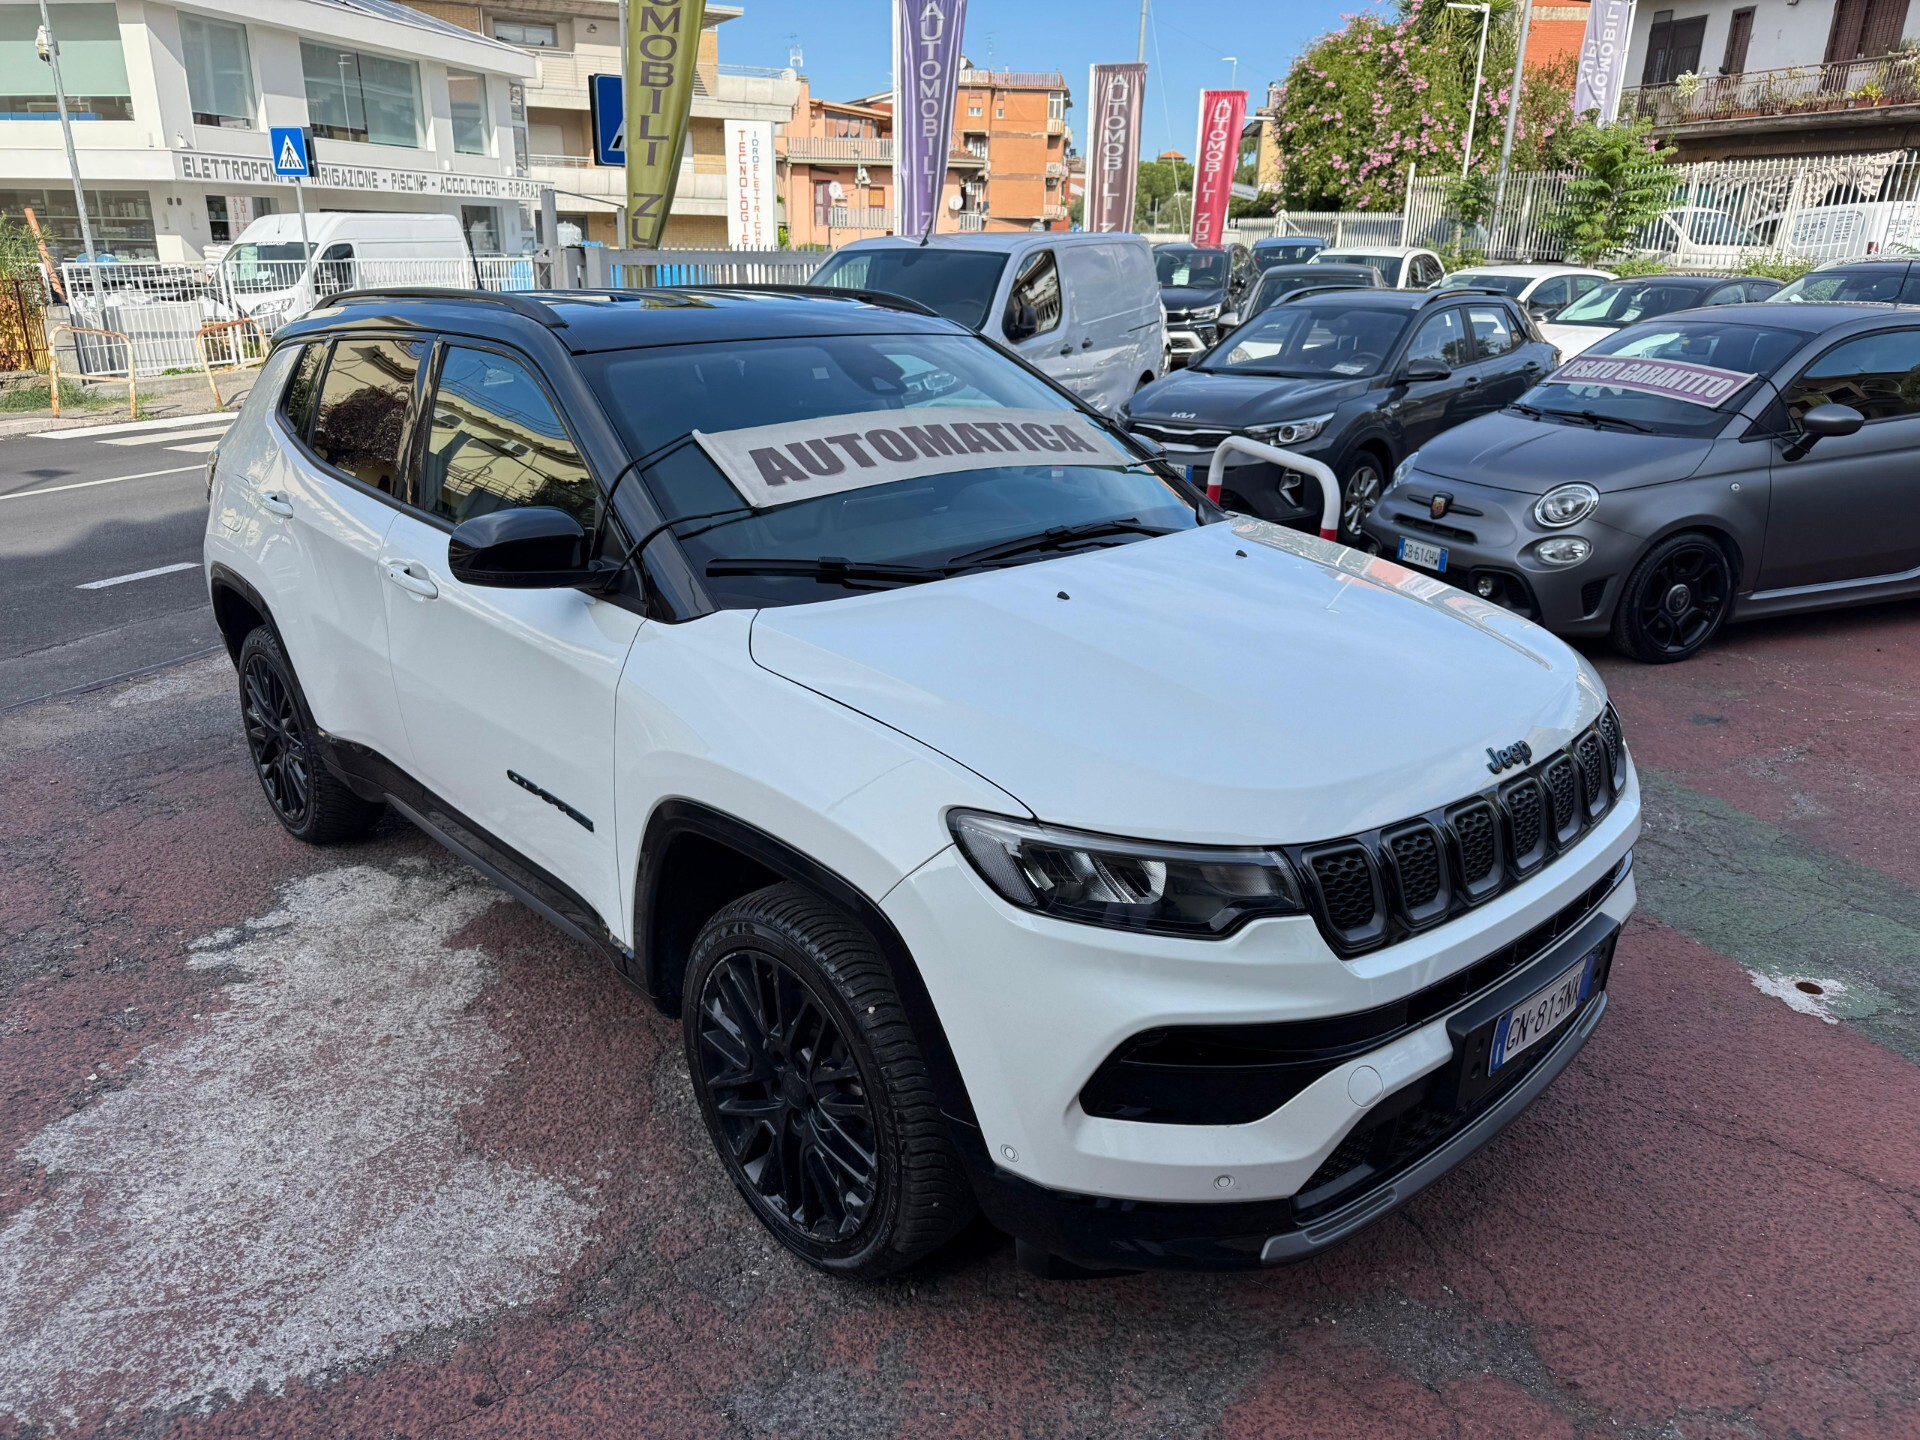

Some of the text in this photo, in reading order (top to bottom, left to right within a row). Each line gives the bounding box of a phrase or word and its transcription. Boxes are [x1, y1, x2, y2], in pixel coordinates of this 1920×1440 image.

[638, 0, 681, 166] MOBILI
[920, 1, 945, 193] AUTOMOBILI
[738, 130, 749, 245] TECNOLOGIE
[752, 130, 762, 245] IDROELETTRICHE
[1102, 74, 1129, 210] AUTOMOBILI
[1202, 99, 1231, 203] AUTOMOBILI
[1561, 360, 1735, 398] USATO GARANTITO
[748, 422, 1098, 486] AUTOMATICA
[1486, 740, 1532, 775] Jeep
